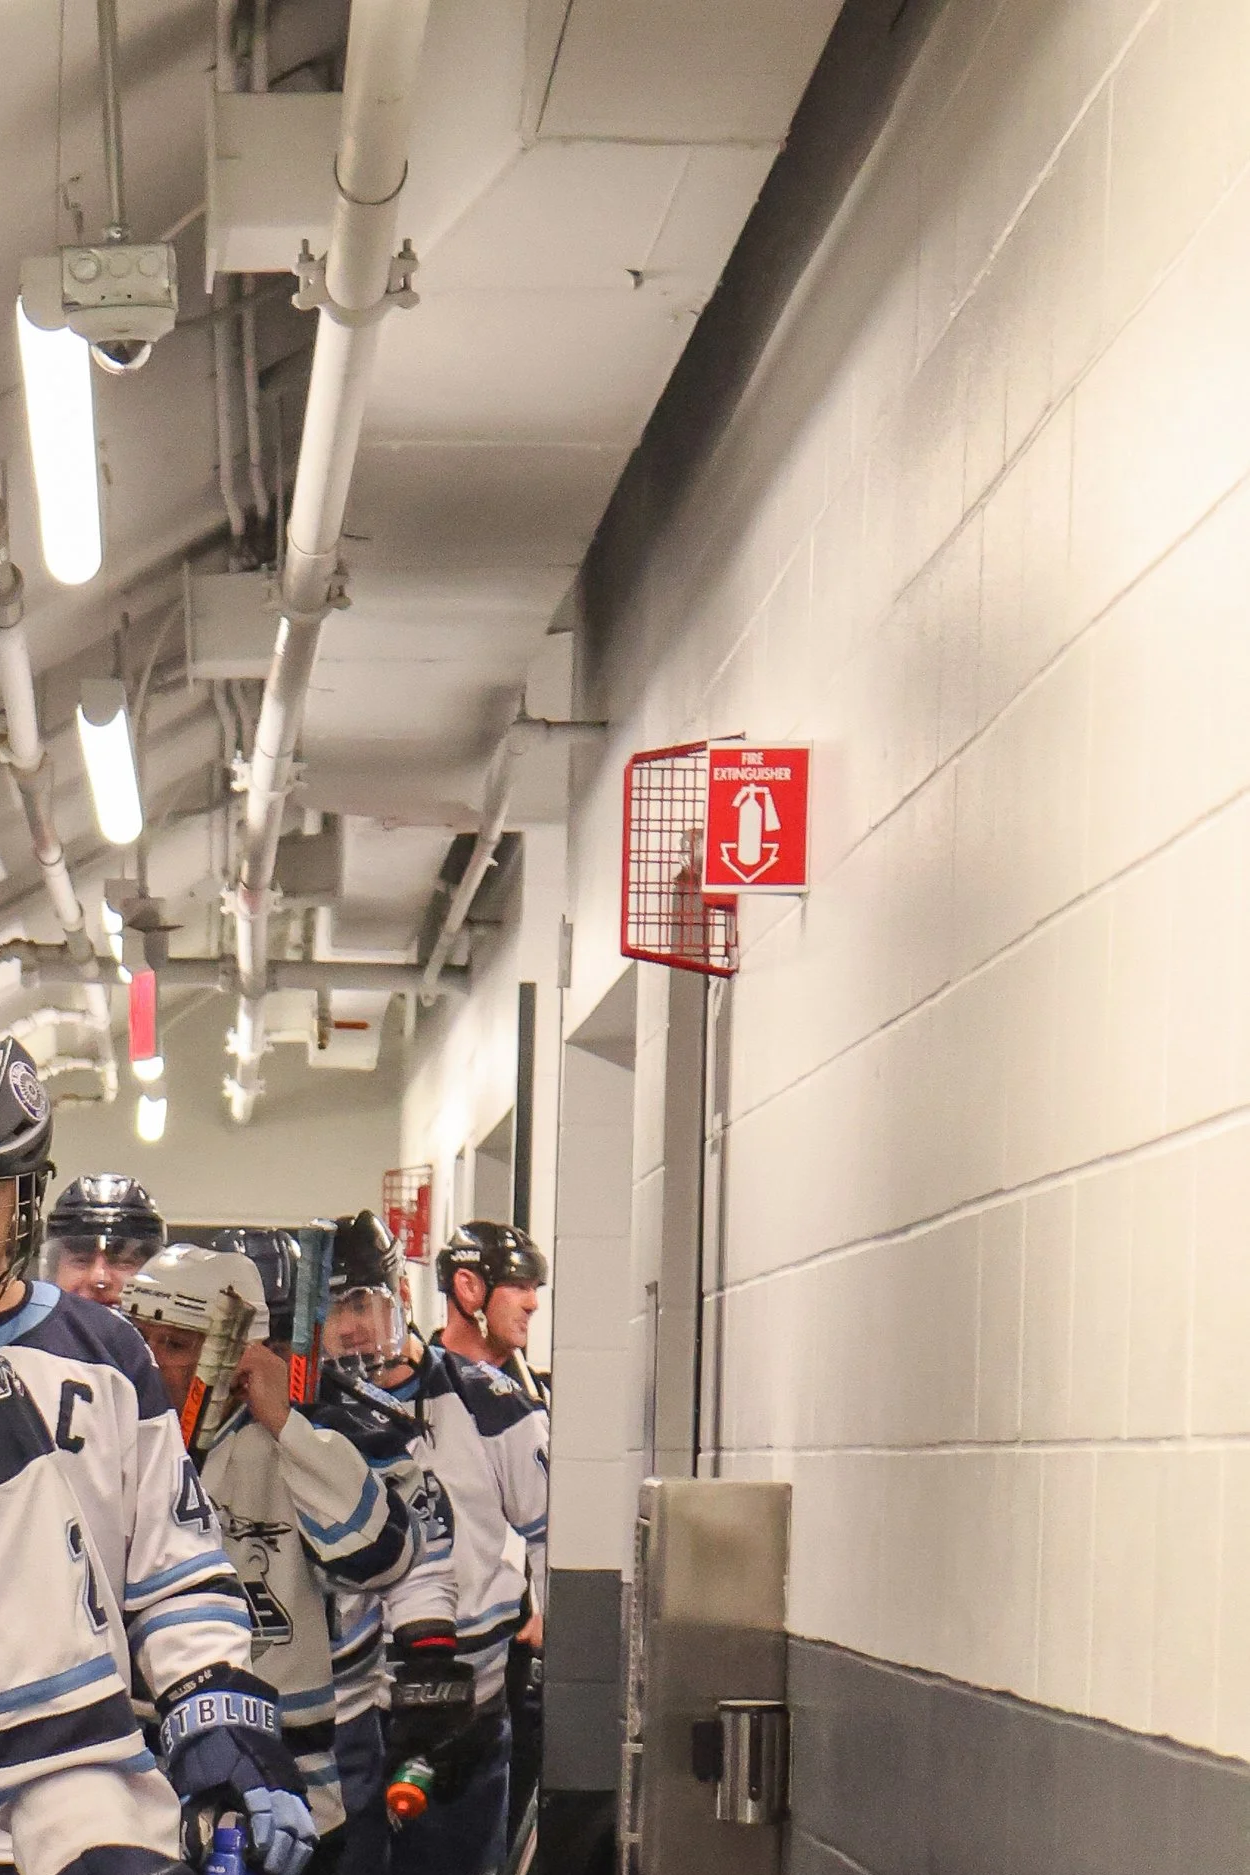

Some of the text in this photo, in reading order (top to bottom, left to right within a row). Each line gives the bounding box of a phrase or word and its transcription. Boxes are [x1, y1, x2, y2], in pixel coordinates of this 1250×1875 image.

[741, 751, 764, 766] FIRE
[713, 767, 792, 781] EXTINGUISHER
[56, 1379, 94, 1454] C
